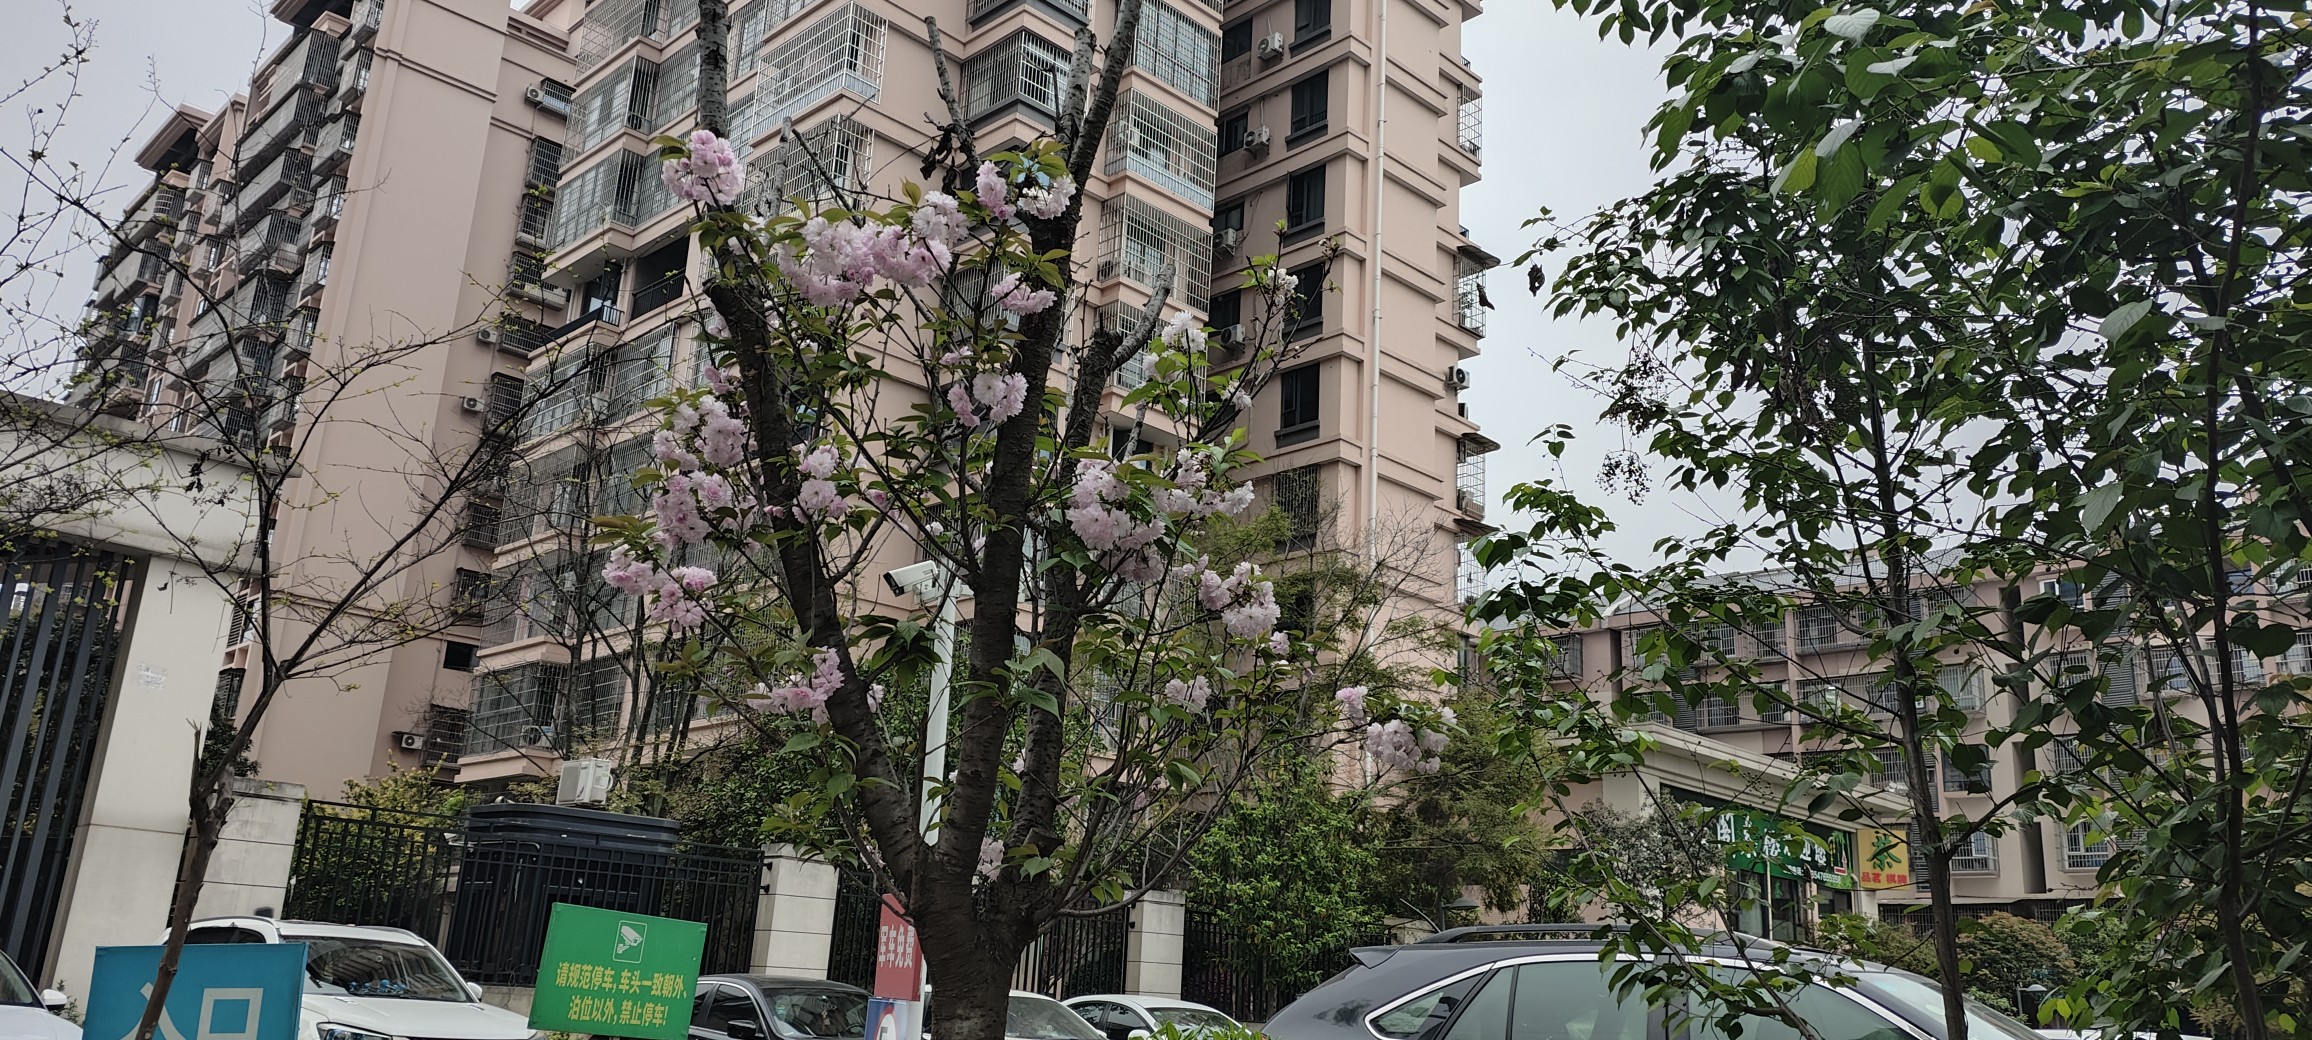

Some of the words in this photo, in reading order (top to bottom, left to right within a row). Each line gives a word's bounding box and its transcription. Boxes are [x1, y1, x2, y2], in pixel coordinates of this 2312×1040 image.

[1866, 833, 1903, 872] 茶
[878, 923, 916, 969] 军车免费
